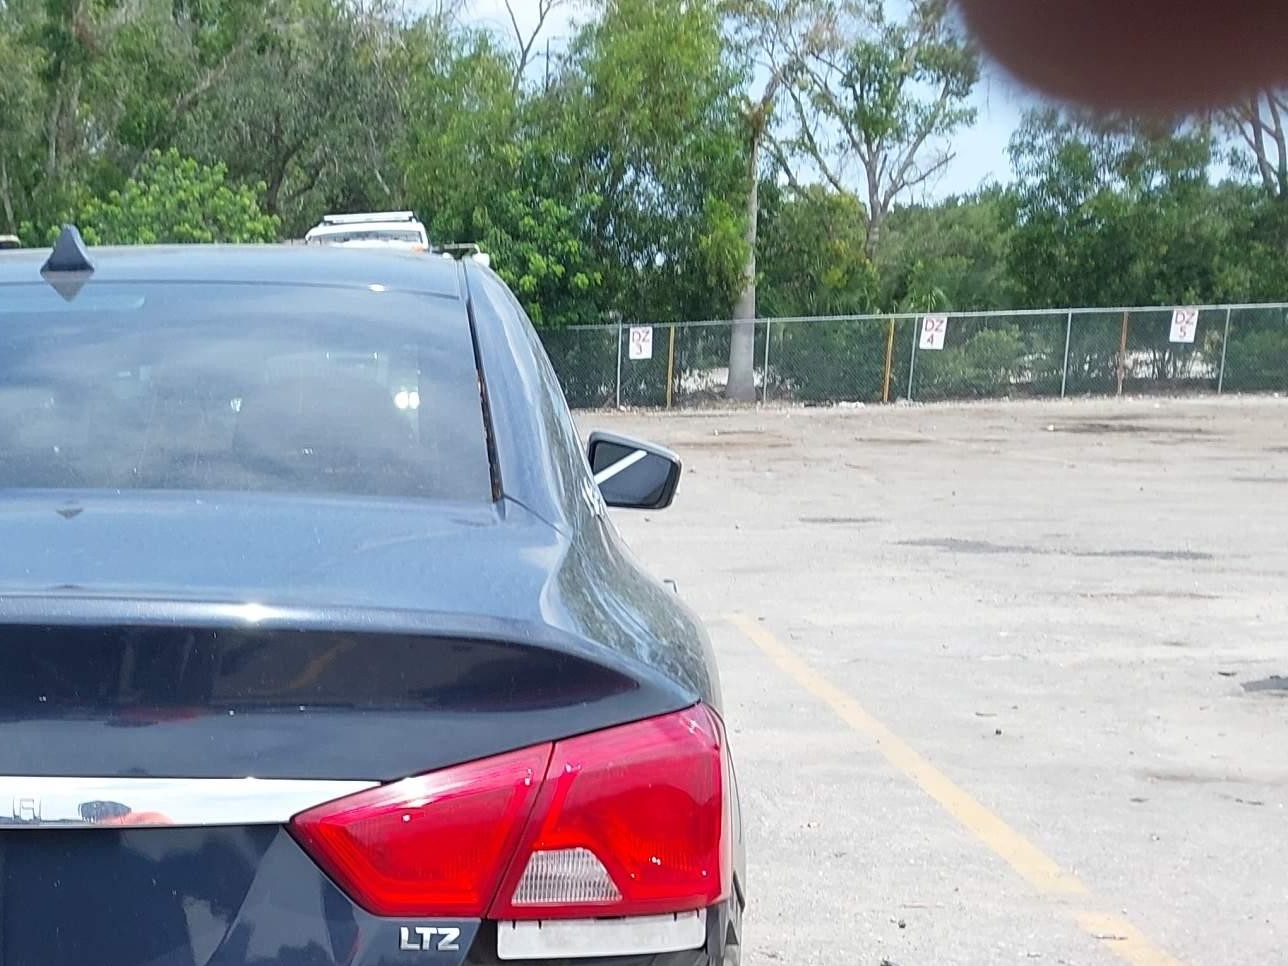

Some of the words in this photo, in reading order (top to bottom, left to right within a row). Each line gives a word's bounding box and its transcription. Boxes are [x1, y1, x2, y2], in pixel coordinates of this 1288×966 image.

[924, 319, 945, 333] DZ
[1175, 311, 1196, 326] DZ
[631, 330, 650, 345] DZ
[926, 333, 935, 346] 4
[1179, 325, 1187, 340] 5
[400, 926, 460, 951] LTZ
